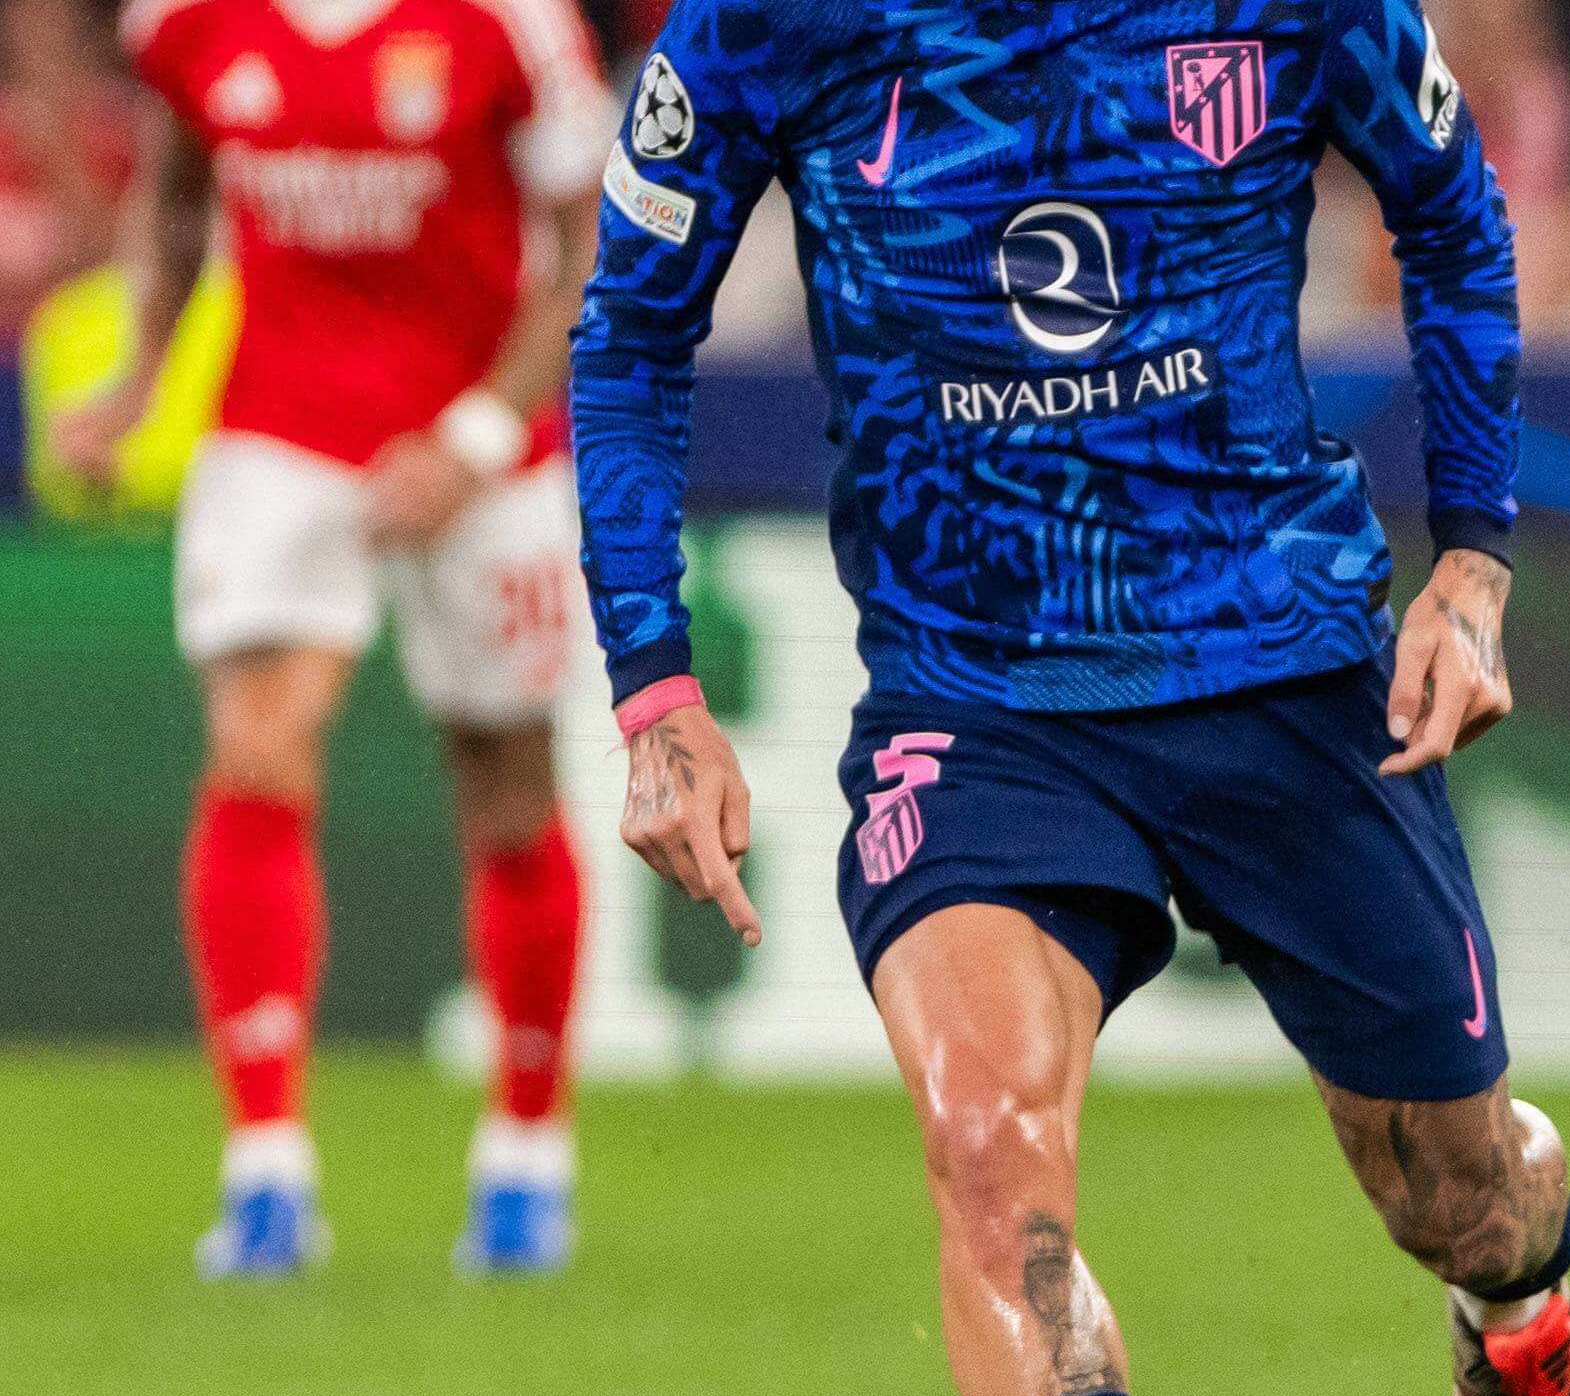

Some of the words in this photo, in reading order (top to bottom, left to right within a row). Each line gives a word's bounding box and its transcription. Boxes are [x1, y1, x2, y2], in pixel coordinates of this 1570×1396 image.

[940, 370, 1119, 421] RIYADH
[1133, 348, 1209, 403] AIR
[865, 732, 956, 818] 5
